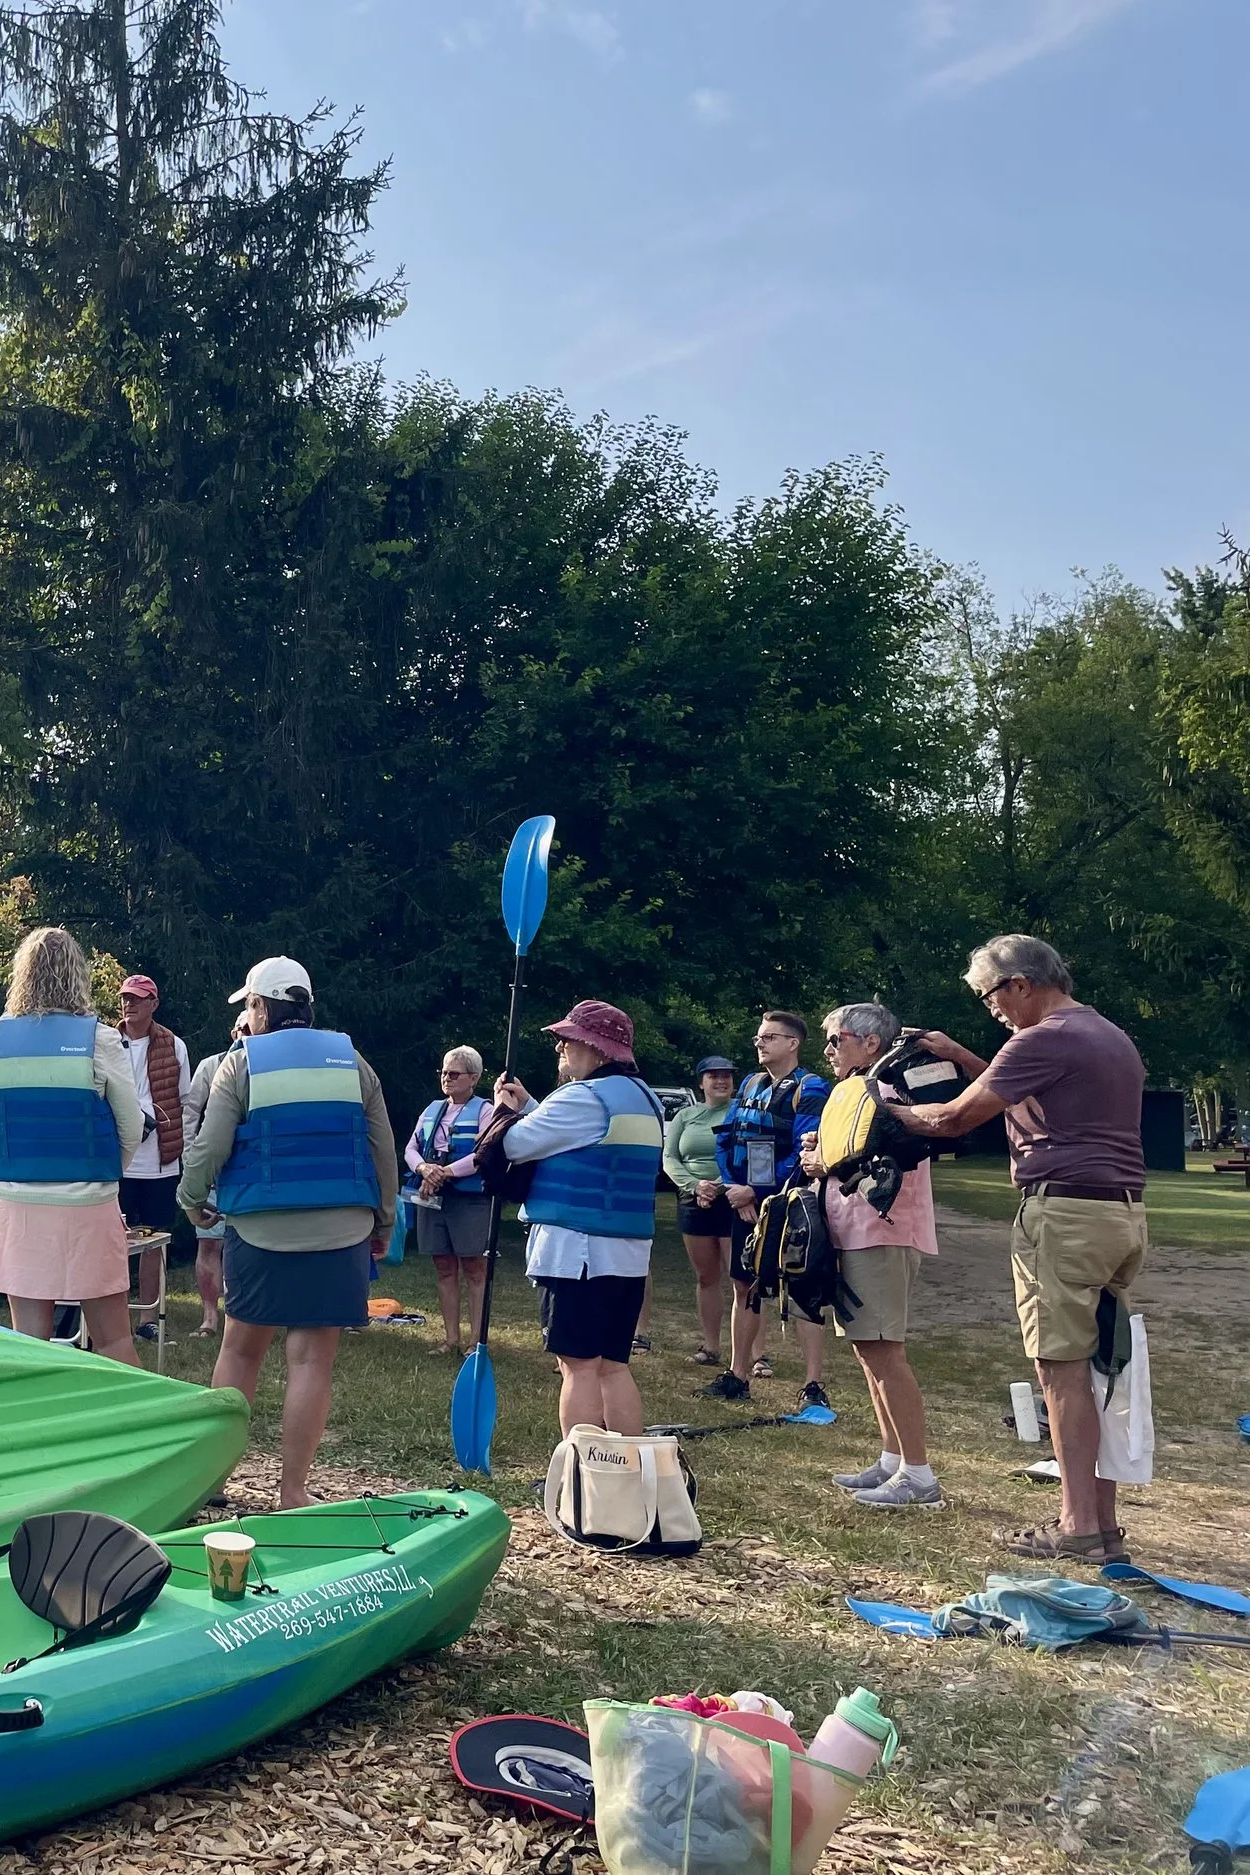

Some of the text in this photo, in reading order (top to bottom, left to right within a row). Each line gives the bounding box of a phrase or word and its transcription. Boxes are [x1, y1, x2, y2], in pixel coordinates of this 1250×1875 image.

[587, 1446, 629, 1465] Kristin
[205, 1593, 319, 1653] WATERTRAIL
[280, 1593, 384, 1640] 269-547-1884
